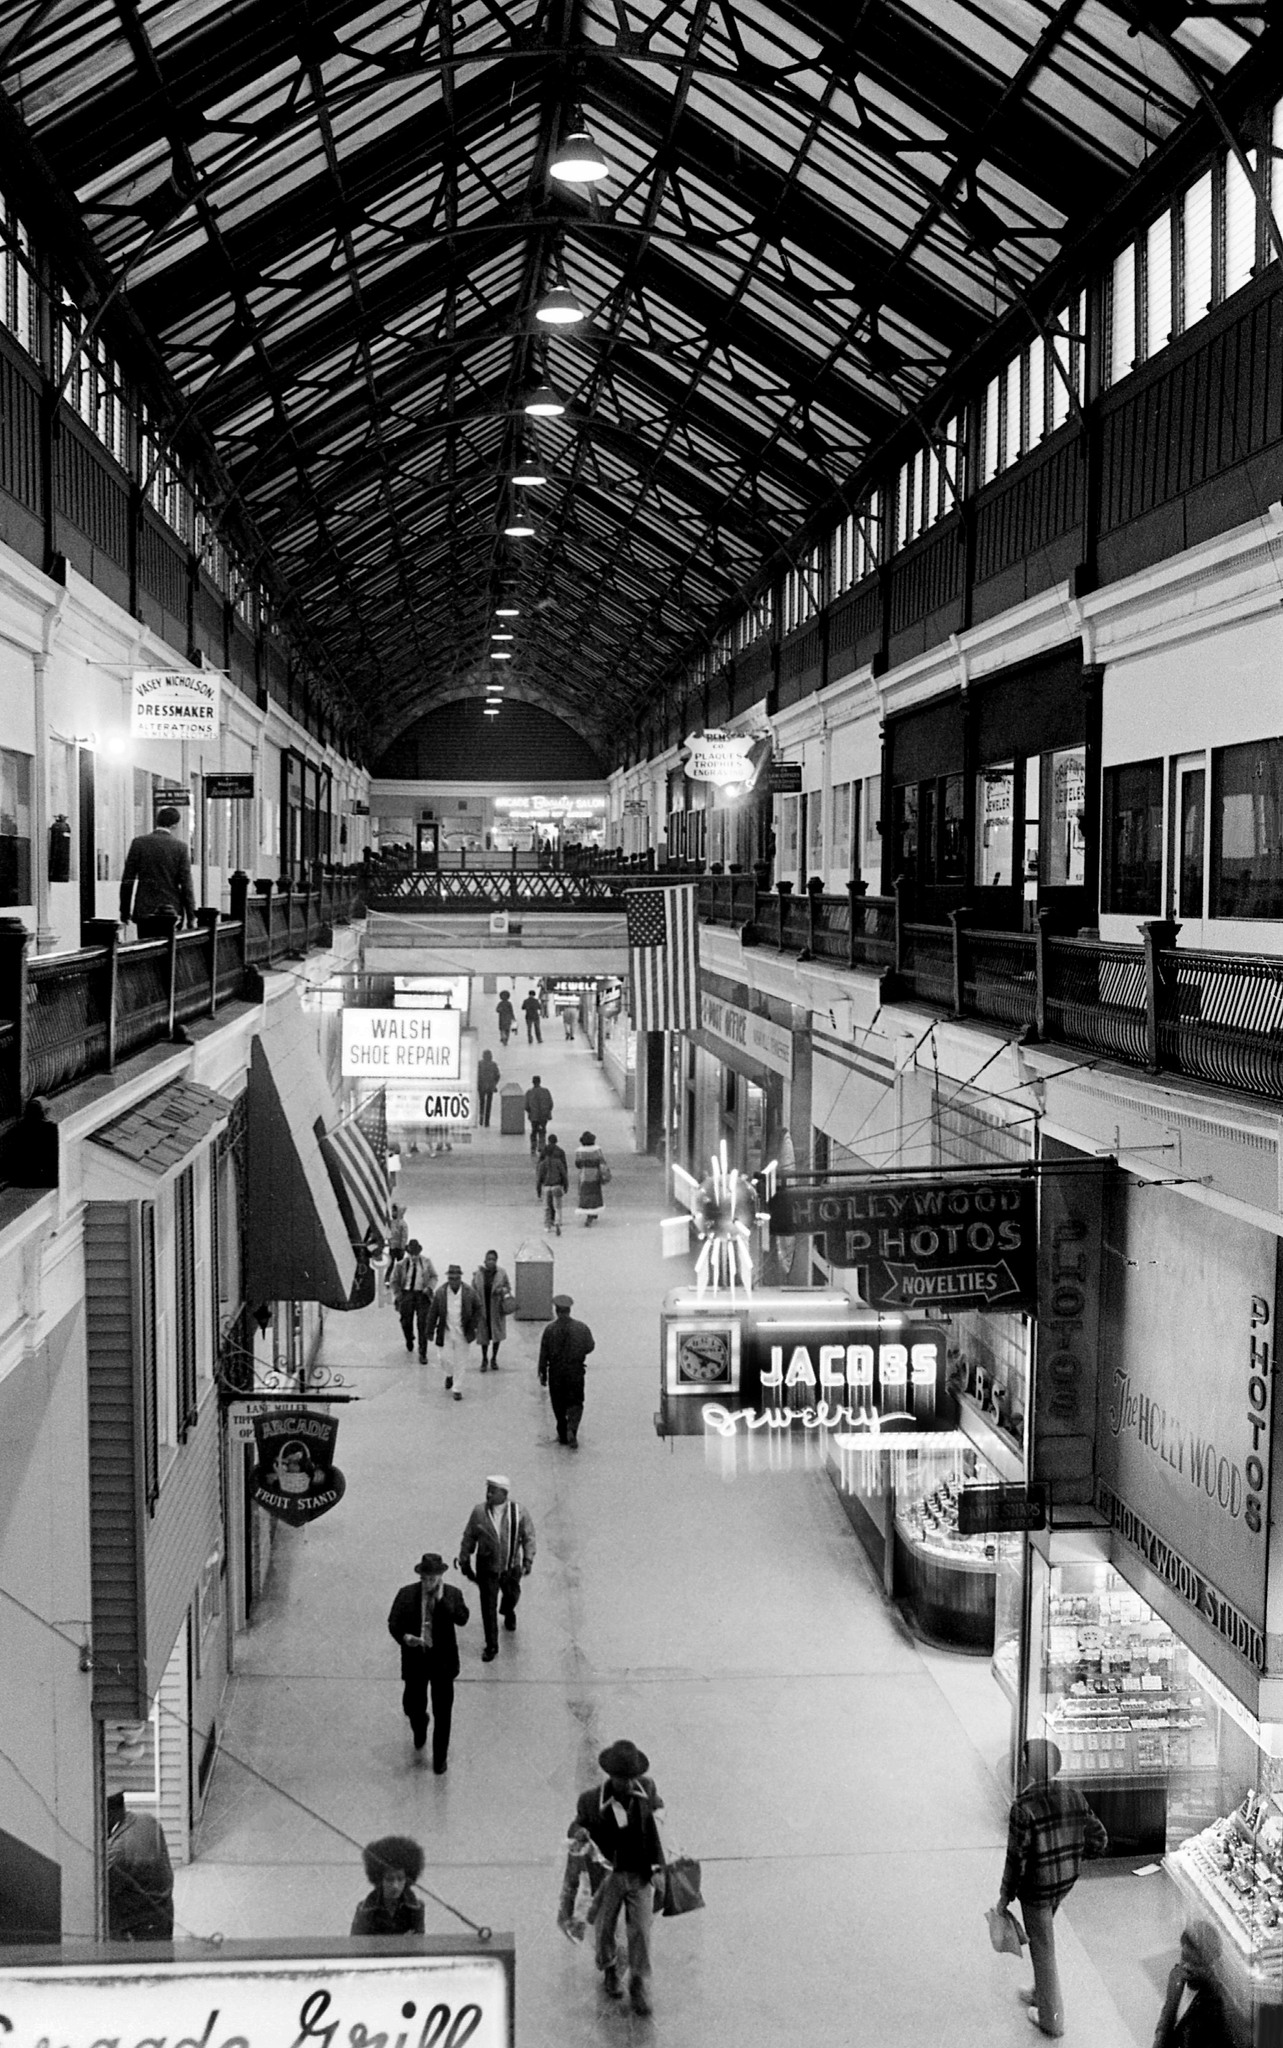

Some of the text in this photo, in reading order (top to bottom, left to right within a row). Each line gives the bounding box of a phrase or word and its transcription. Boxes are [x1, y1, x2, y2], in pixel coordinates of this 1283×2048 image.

[136, 678, 161, 697] VASEY
[137, 704, 214, 718] DRESSMAKER
[138, 723, 213, 732] ALTERATIONS
[695, 752, 742, 760] PLAQUES
[576, 799, 604, 808] SALON
[554, 982, 597, 991] JEWELE
[371, 1019, 431, 1039] WALSH
[350, 1045, 451, 1066] SHOE REPAIR
[425, 1093, 469, 1118] CATO'S
[793, 1187, 1021, 1224] HOLLYWOOD
[845, 1220, 1021, 1259] PHOTOS
[902, 1272, 998, 1294] NOVELTIES
[760, 1344, 938, 1386] JACOBS
[702, 1400, 916, 1436] Jewelry
[1245, 1295, 1269, 1532] PHOTOS
[262, 1417, 333, 1441] ARCADE
[1110, 1367, 1242, 1519] The HOLLYWOOD
[255, 1487, 337, 1510] FRUIT STAND
[1116, 1497, 1199, 1606] HOLLYWOOD
[1204, 1586, 1264, 1671] STUDIO
